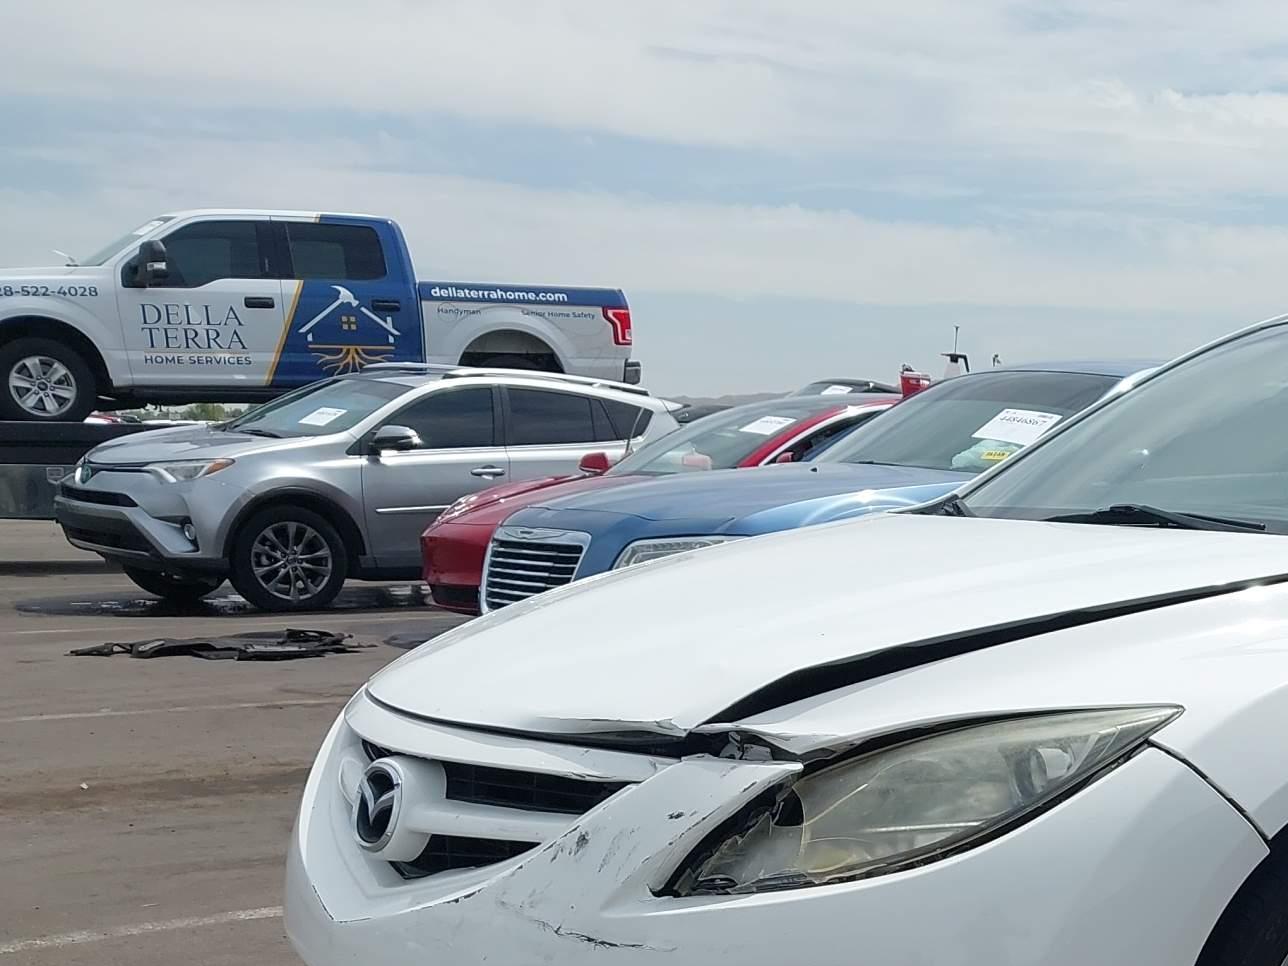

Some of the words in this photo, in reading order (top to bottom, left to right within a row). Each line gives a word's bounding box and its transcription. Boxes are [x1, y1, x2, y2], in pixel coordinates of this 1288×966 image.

[431, 286, 568, 302] dellaterrahome.com
[140, 303, 244, 326] DELLA
[437, 307, 481, 316] Handyman
[572, 311, 595, 320] Safety
[141, 327, 248, 349] TERRA
[144, 355, 184, 365] HOME
[188, 355, 252, 366] SERVICES
